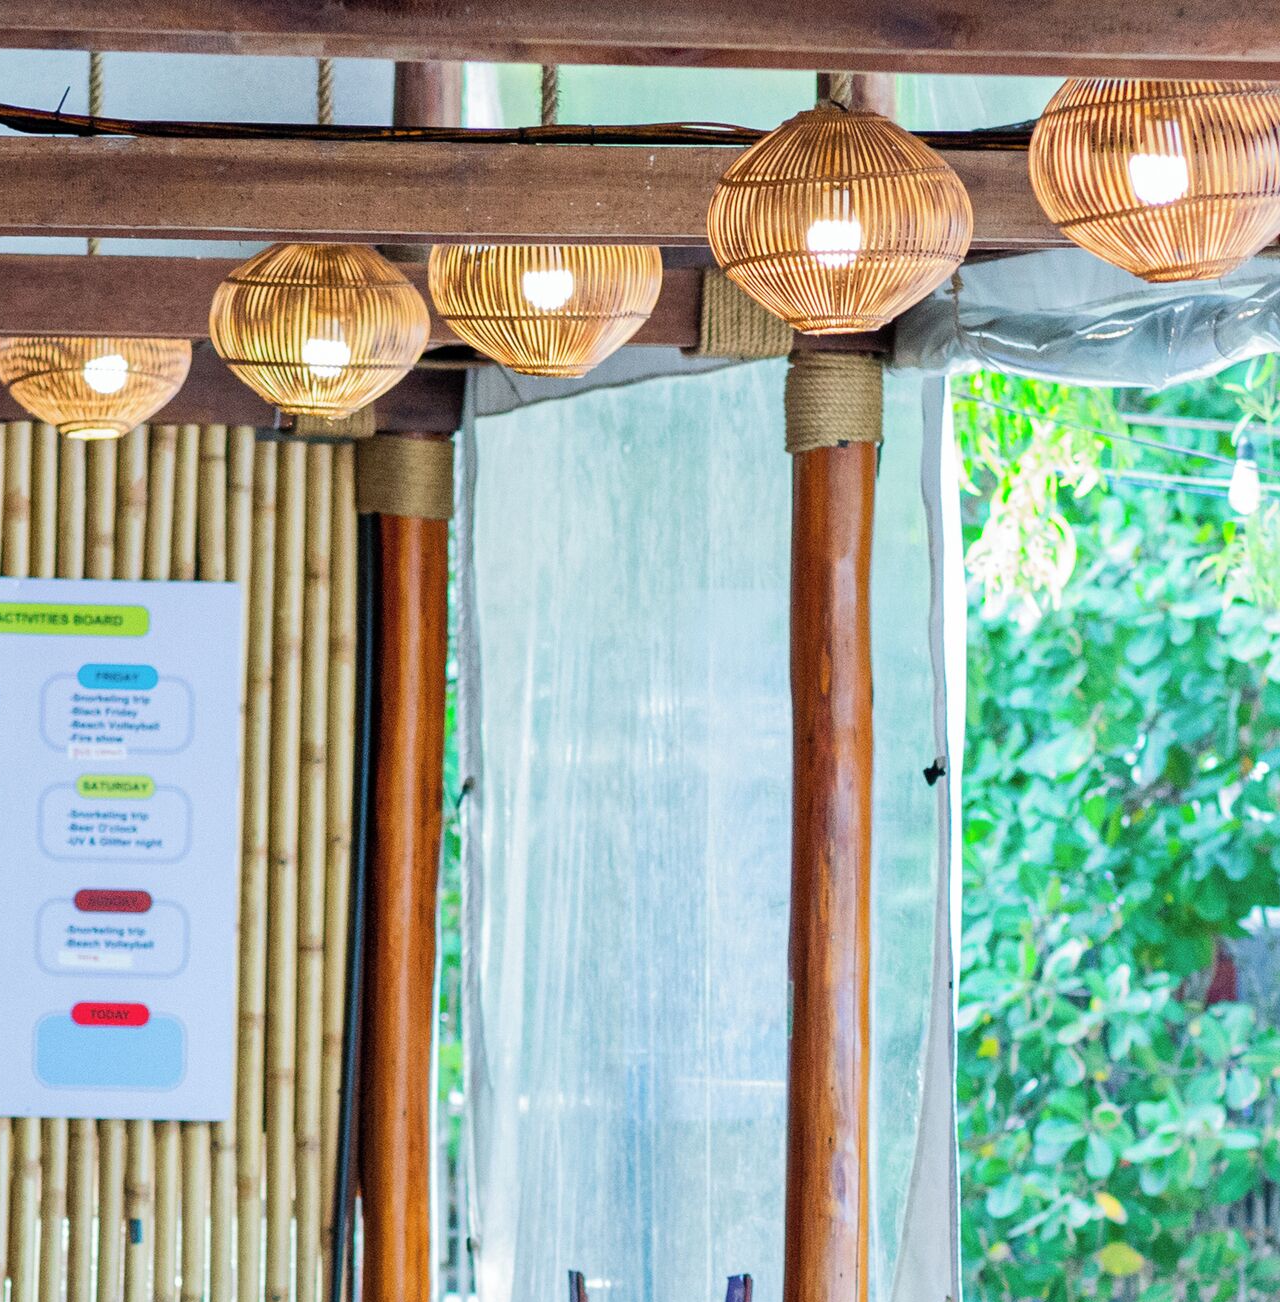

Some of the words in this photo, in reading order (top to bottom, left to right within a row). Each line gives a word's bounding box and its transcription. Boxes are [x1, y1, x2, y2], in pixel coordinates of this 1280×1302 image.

[72, 613, 124, 626] BOARD
[96, 672, 139, 682] FRIDAY
[83, 780, 148, 792] SATURDAY
[90, 1009, 130, 1020] TODAY
